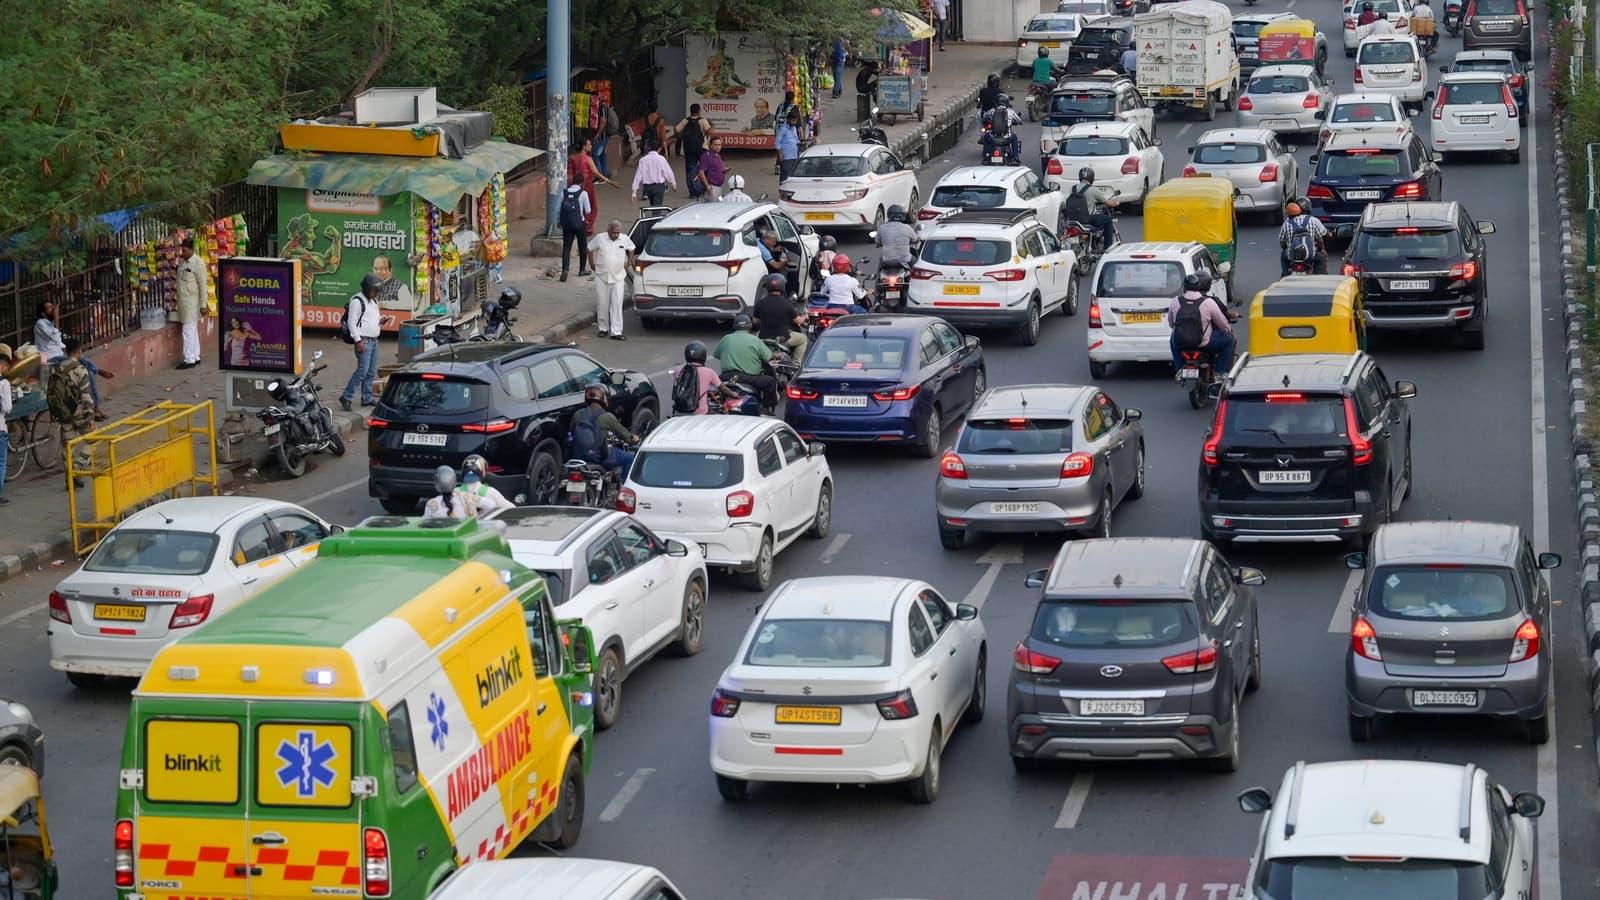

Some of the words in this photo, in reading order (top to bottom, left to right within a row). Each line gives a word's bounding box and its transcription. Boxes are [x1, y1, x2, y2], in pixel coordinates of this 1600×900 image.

[724, 137, 744, 145] 1033
[746, 137, 768, 145] 2007
[343, 230, 407, 250] शाकाहारी
[240, 277, 280, 289] COBRA
[234, 294, 251, 304] Safe
[252, 296, 275, 304] Hands
[263, 306, 284, 315] Gloves
[306, 309, 323, 321] 99
[476, 646, 523, 708] blinkit
[164, 753, 222, 772] blinkit
[447, 709, 532, 824] AMBULANCE
